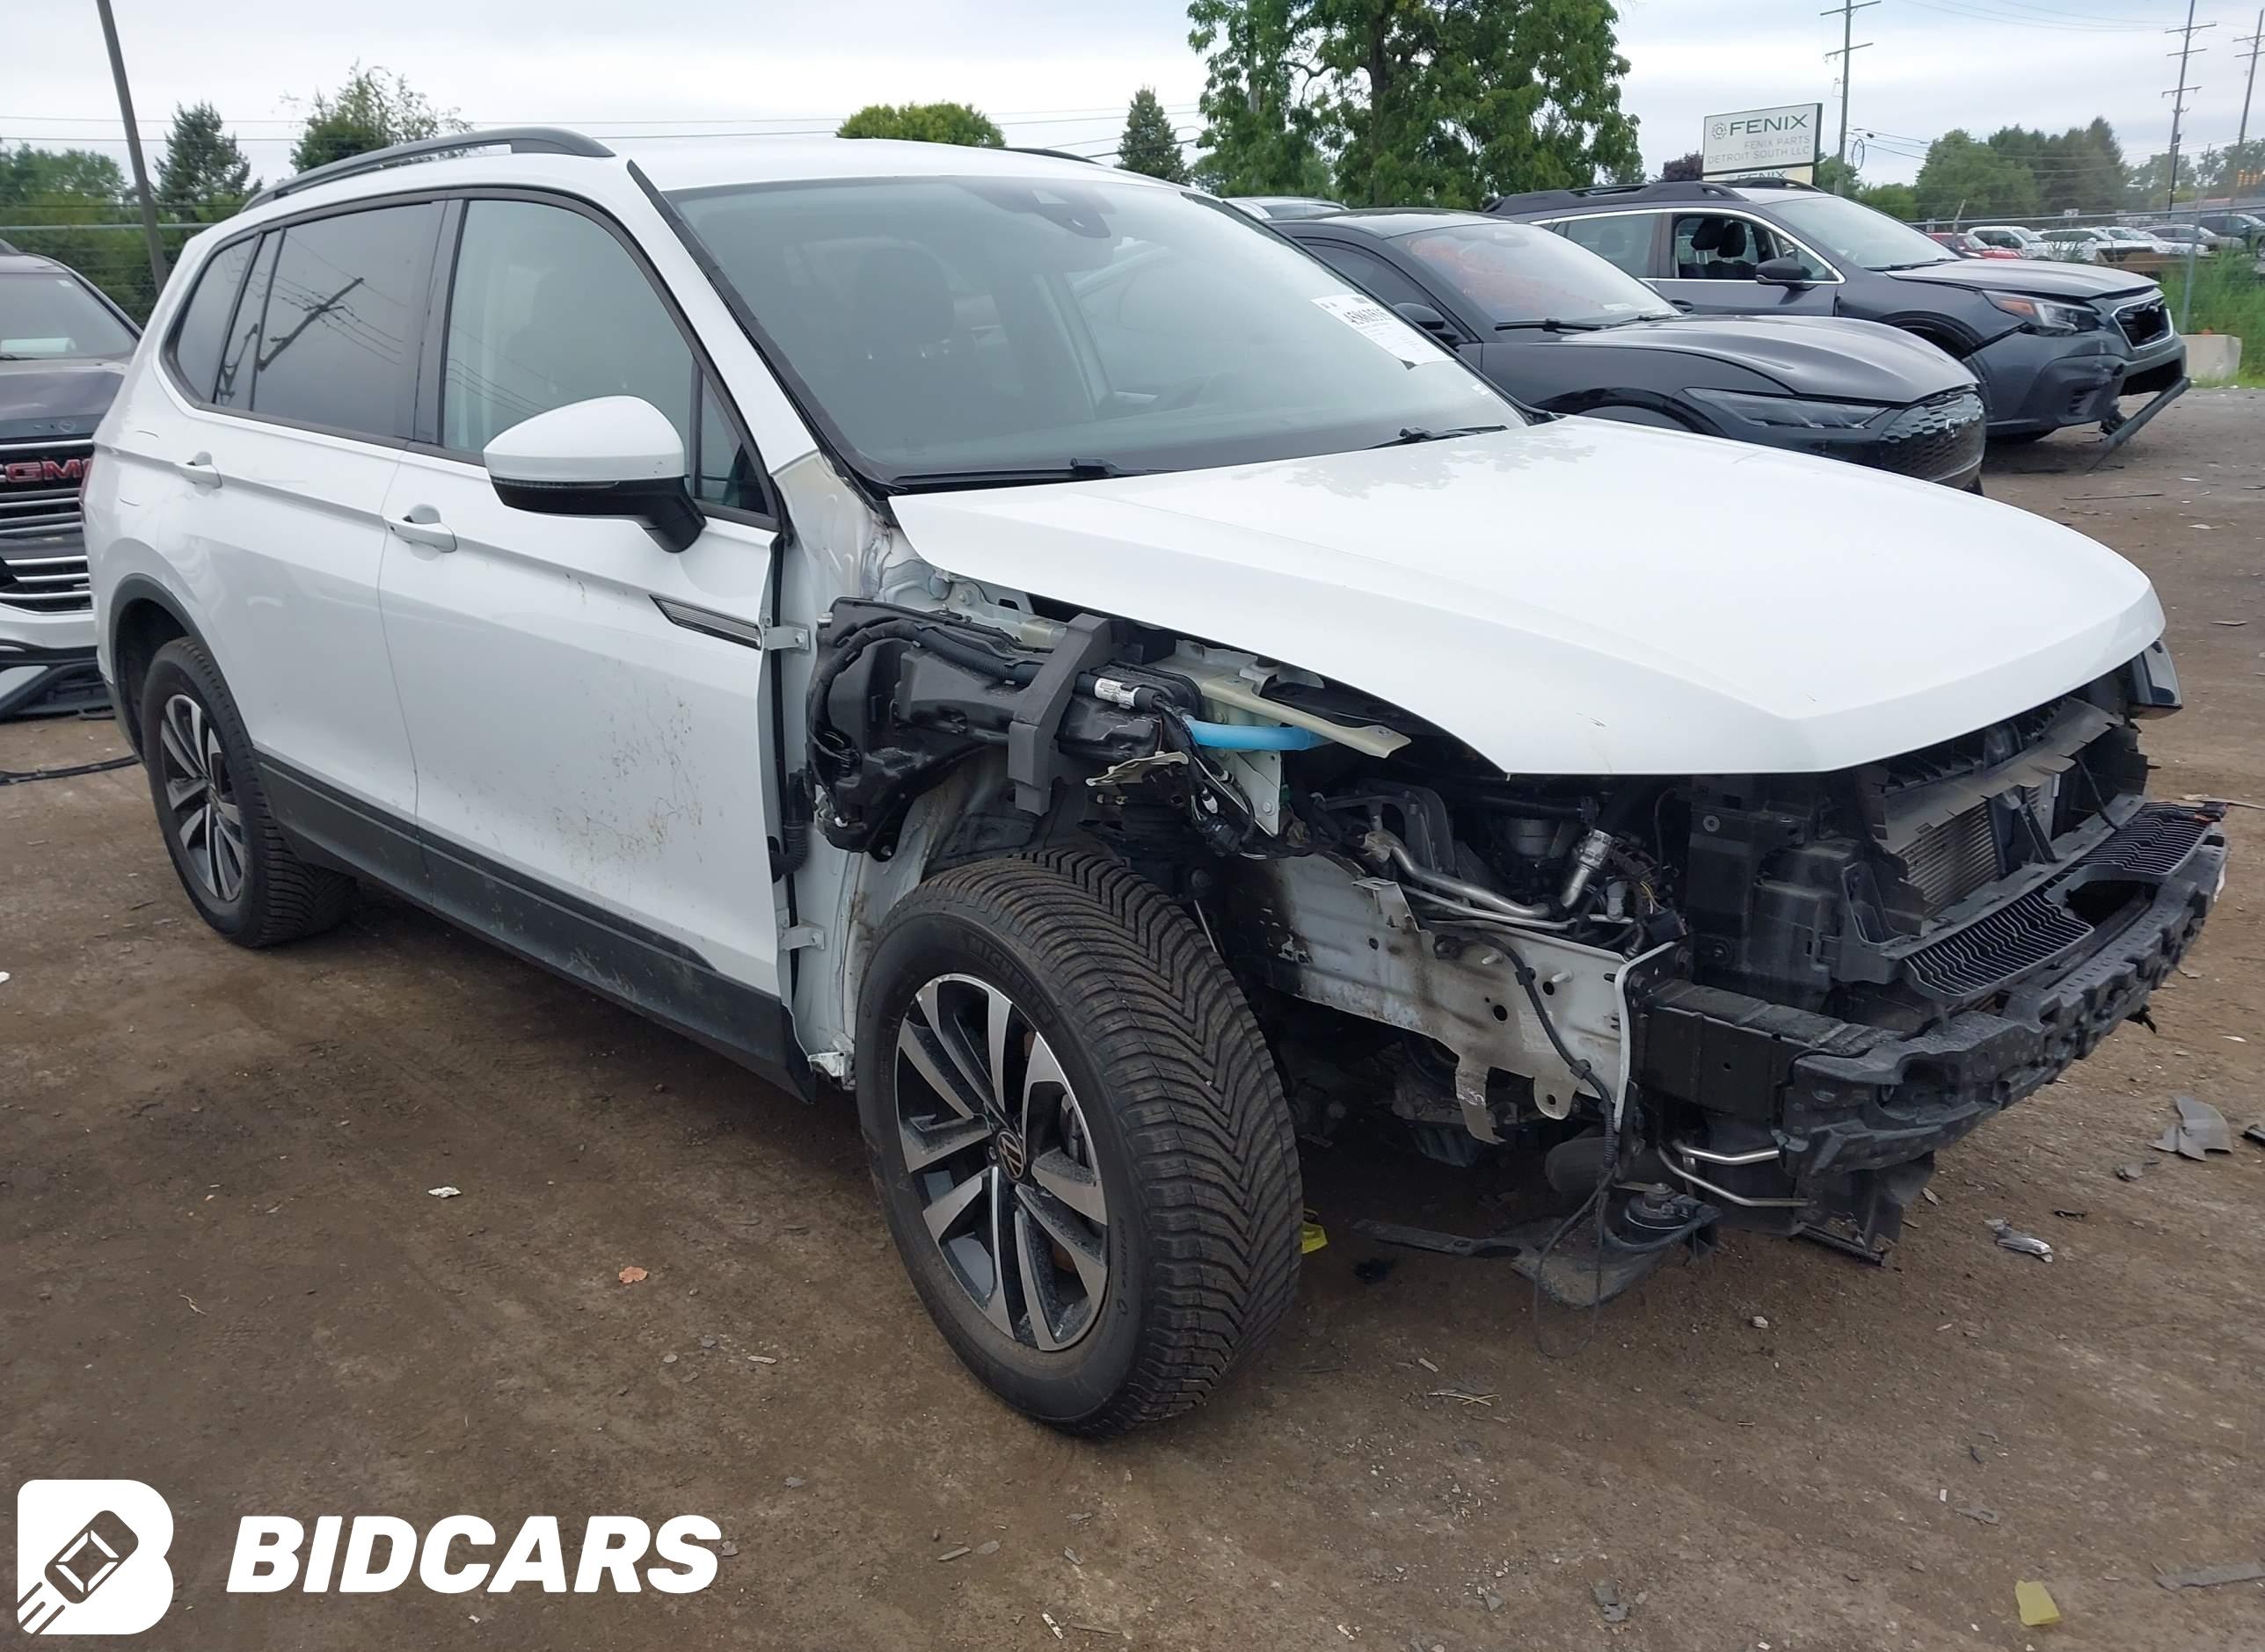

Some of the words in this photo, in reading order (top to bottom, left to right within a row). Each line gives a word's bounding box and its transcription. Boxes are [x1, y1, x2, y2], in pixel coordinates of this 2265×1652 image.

[1730, 113, 1808, 136] FENIX
[1744, 140, 1773, 149] FENIX
[1777, 135, 1810, 146] PARTS
[1708, 151, 1750, 164] DETROIT
[1753, 148, 1788, 159] SOUTH
[1791, 146, 1810, 156] LLC
[5, 458, 91, 483] GM
